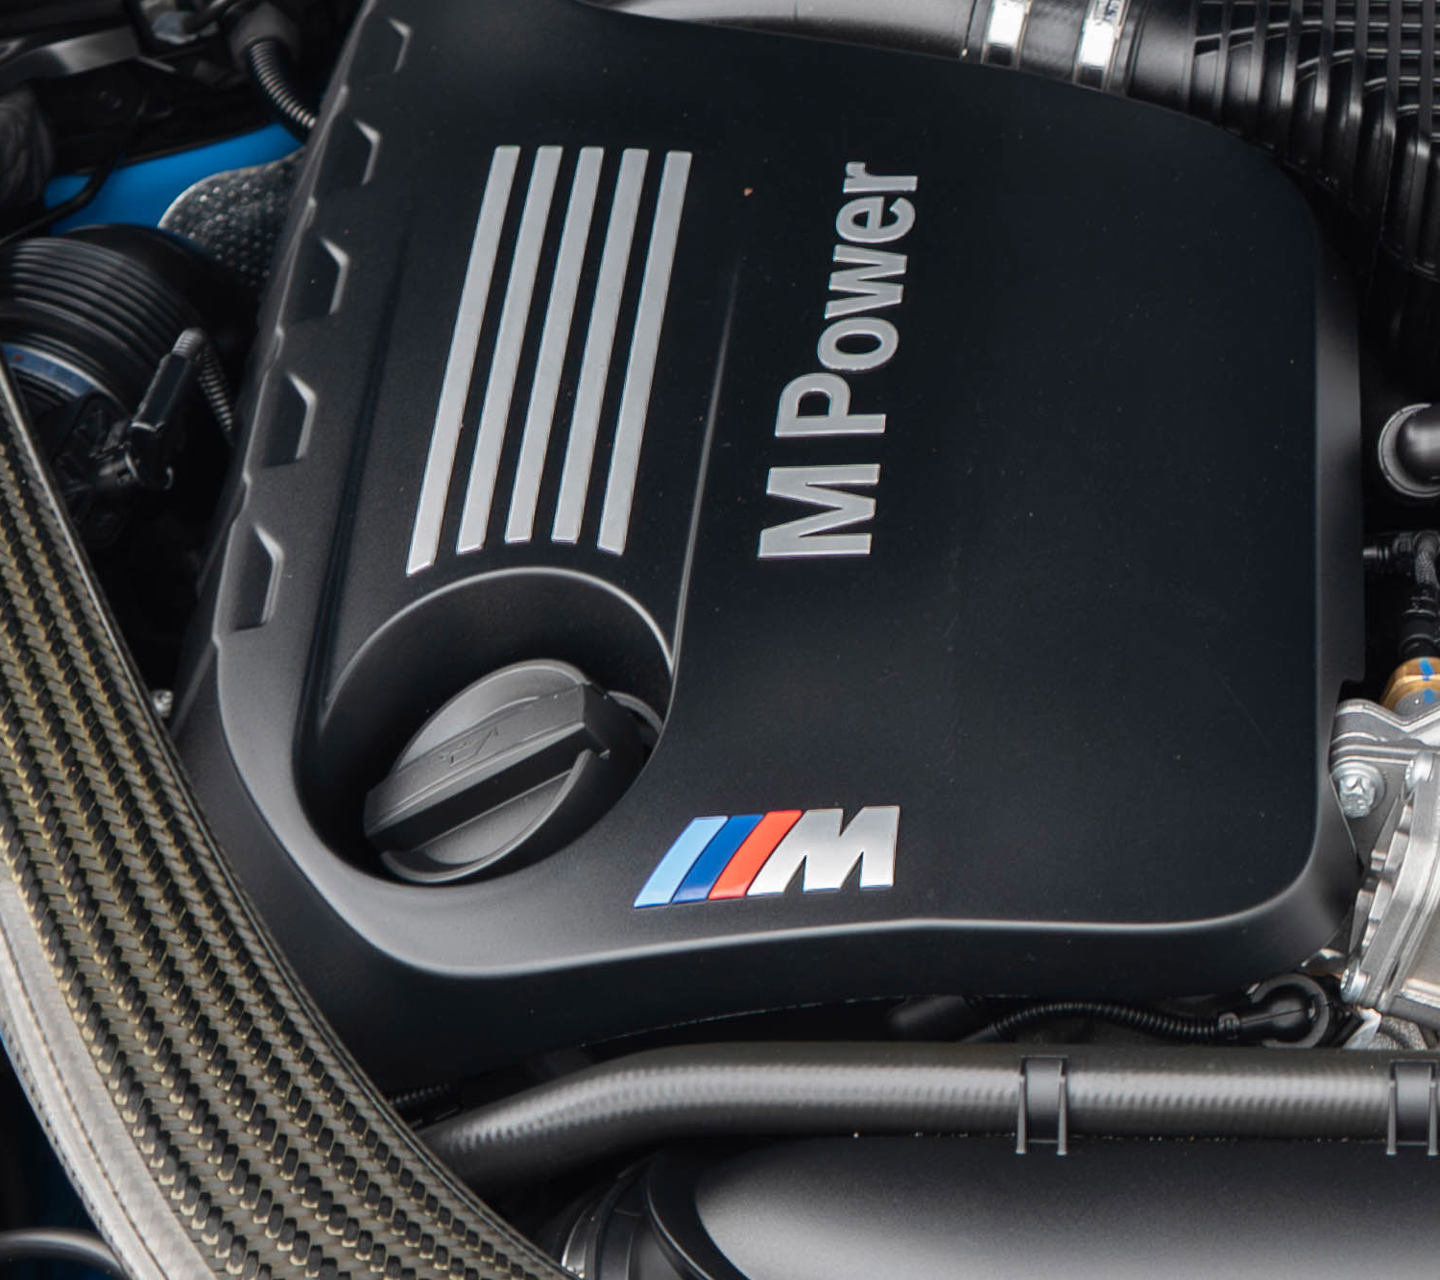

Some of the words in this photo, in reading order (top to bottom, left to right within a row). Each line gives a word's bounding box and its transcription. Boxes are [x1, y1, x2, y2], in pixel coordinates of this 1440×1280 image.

[775, 161, 919, 437] Power
[759, 464, 881, 560] M
[746, 806, 900, 897] M
